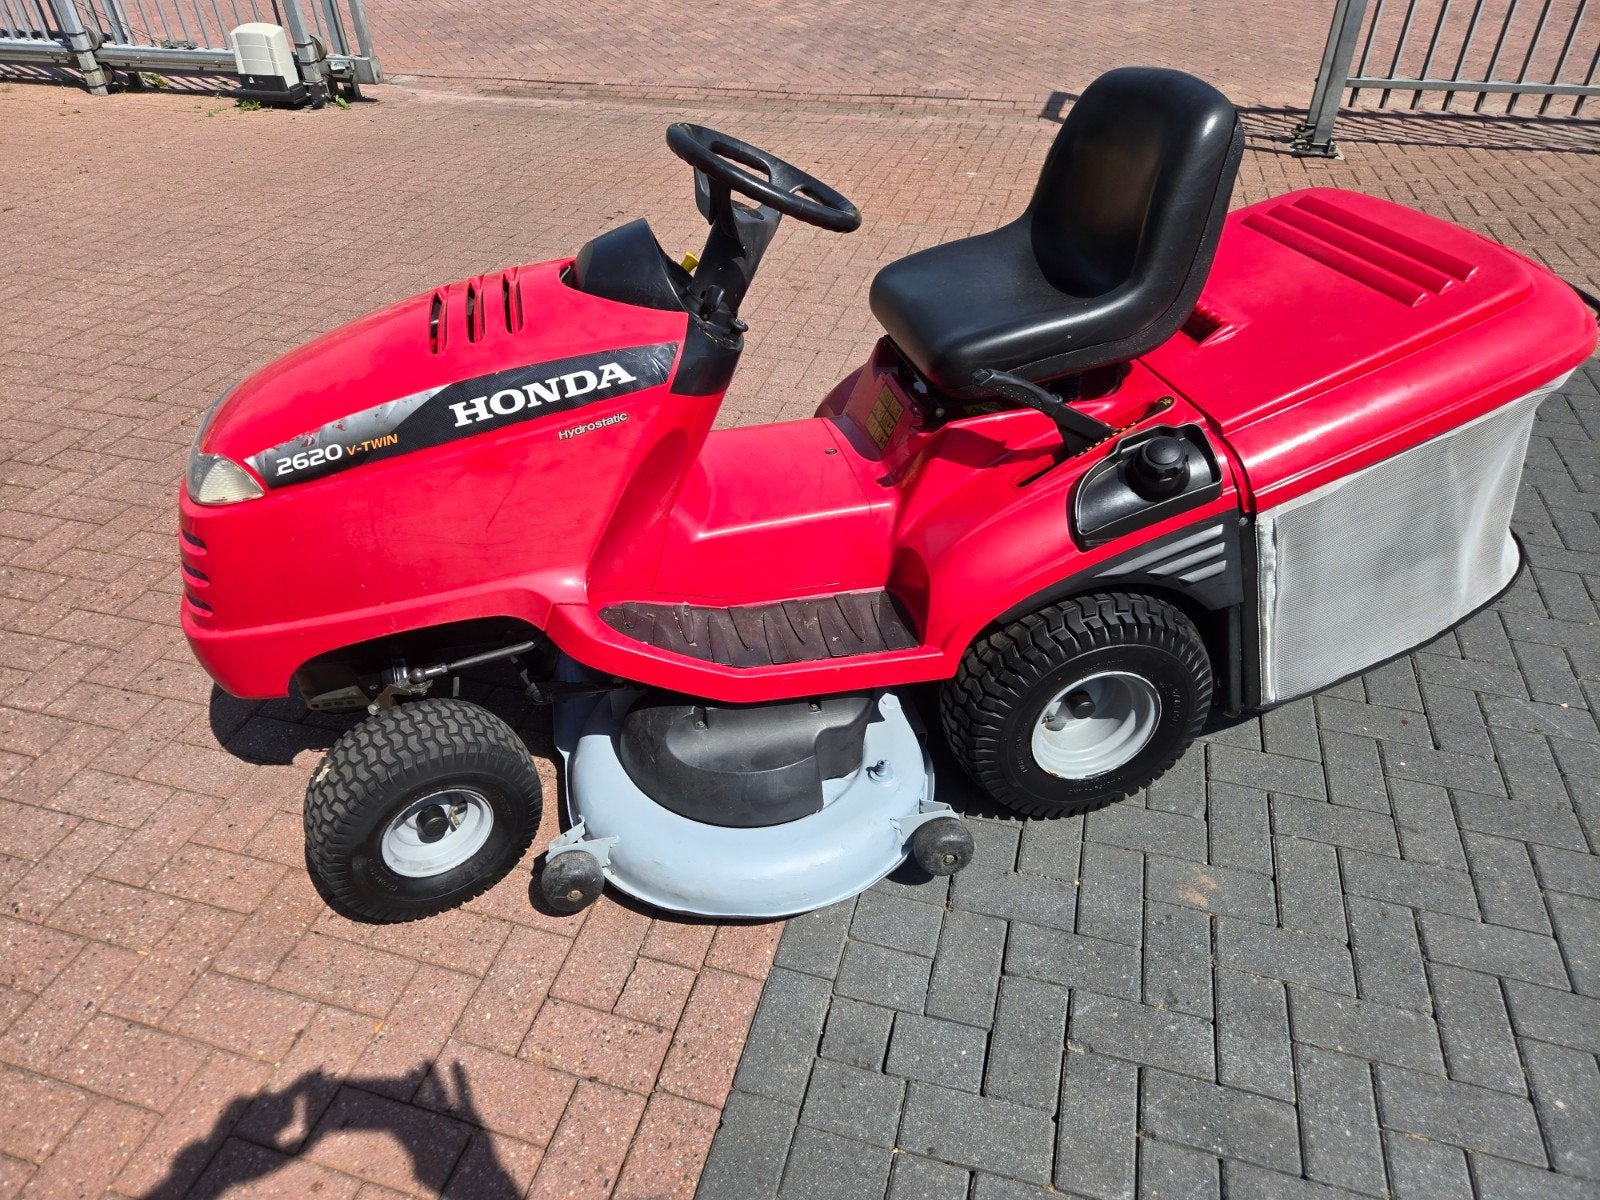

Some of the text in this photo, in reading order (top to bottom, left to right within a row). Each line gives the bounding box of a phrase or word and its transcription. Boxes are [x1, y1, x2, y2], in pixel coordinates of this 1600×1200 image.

[449, 362, 636, 427] HONDA
[558, 412, 628, 440] Hydrostatic
[276, 434, 398, 476] 2620 V-TWIN
